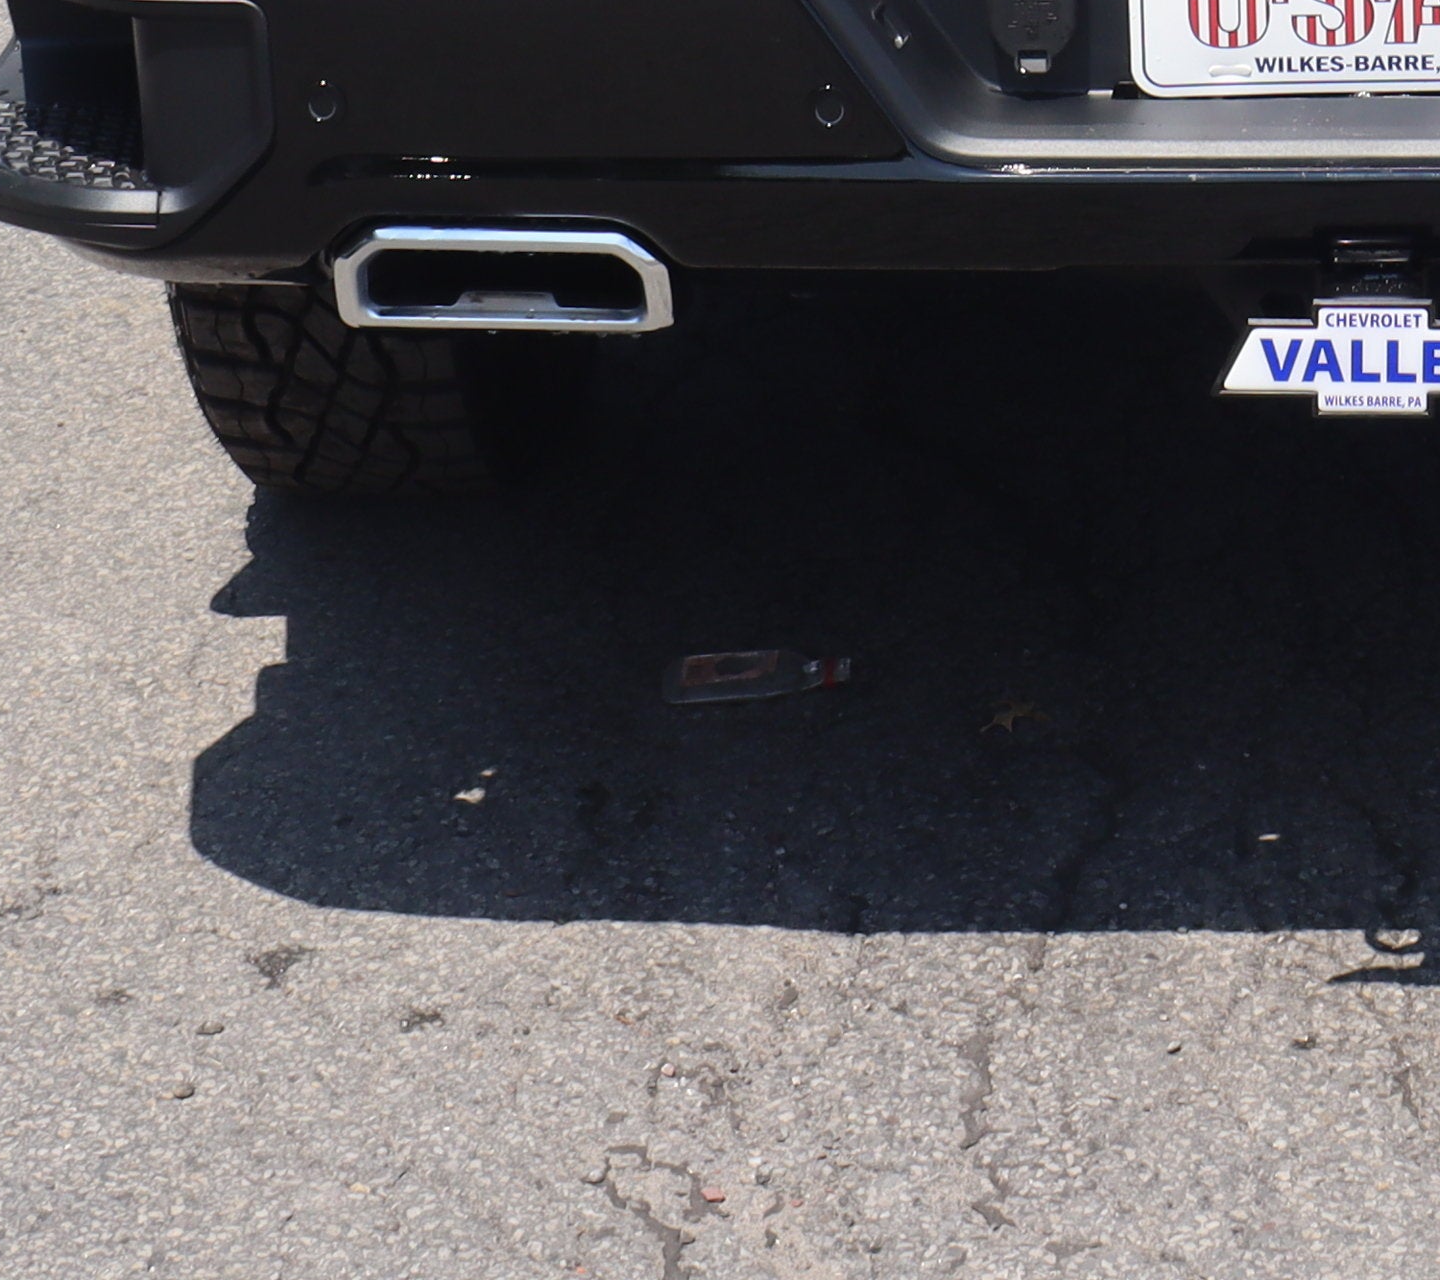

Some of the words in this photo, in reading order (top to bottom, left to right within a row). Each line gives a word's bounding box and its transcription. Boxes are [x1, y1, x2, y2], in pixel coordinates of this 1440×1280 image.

[1325, 313, 1423, 329] CHEVROLET
[1324, 395, 1364, 407] WILKES
[1367, 396, 1405, 409] BARRE,
[1408, 397, 1422, 408] PA
